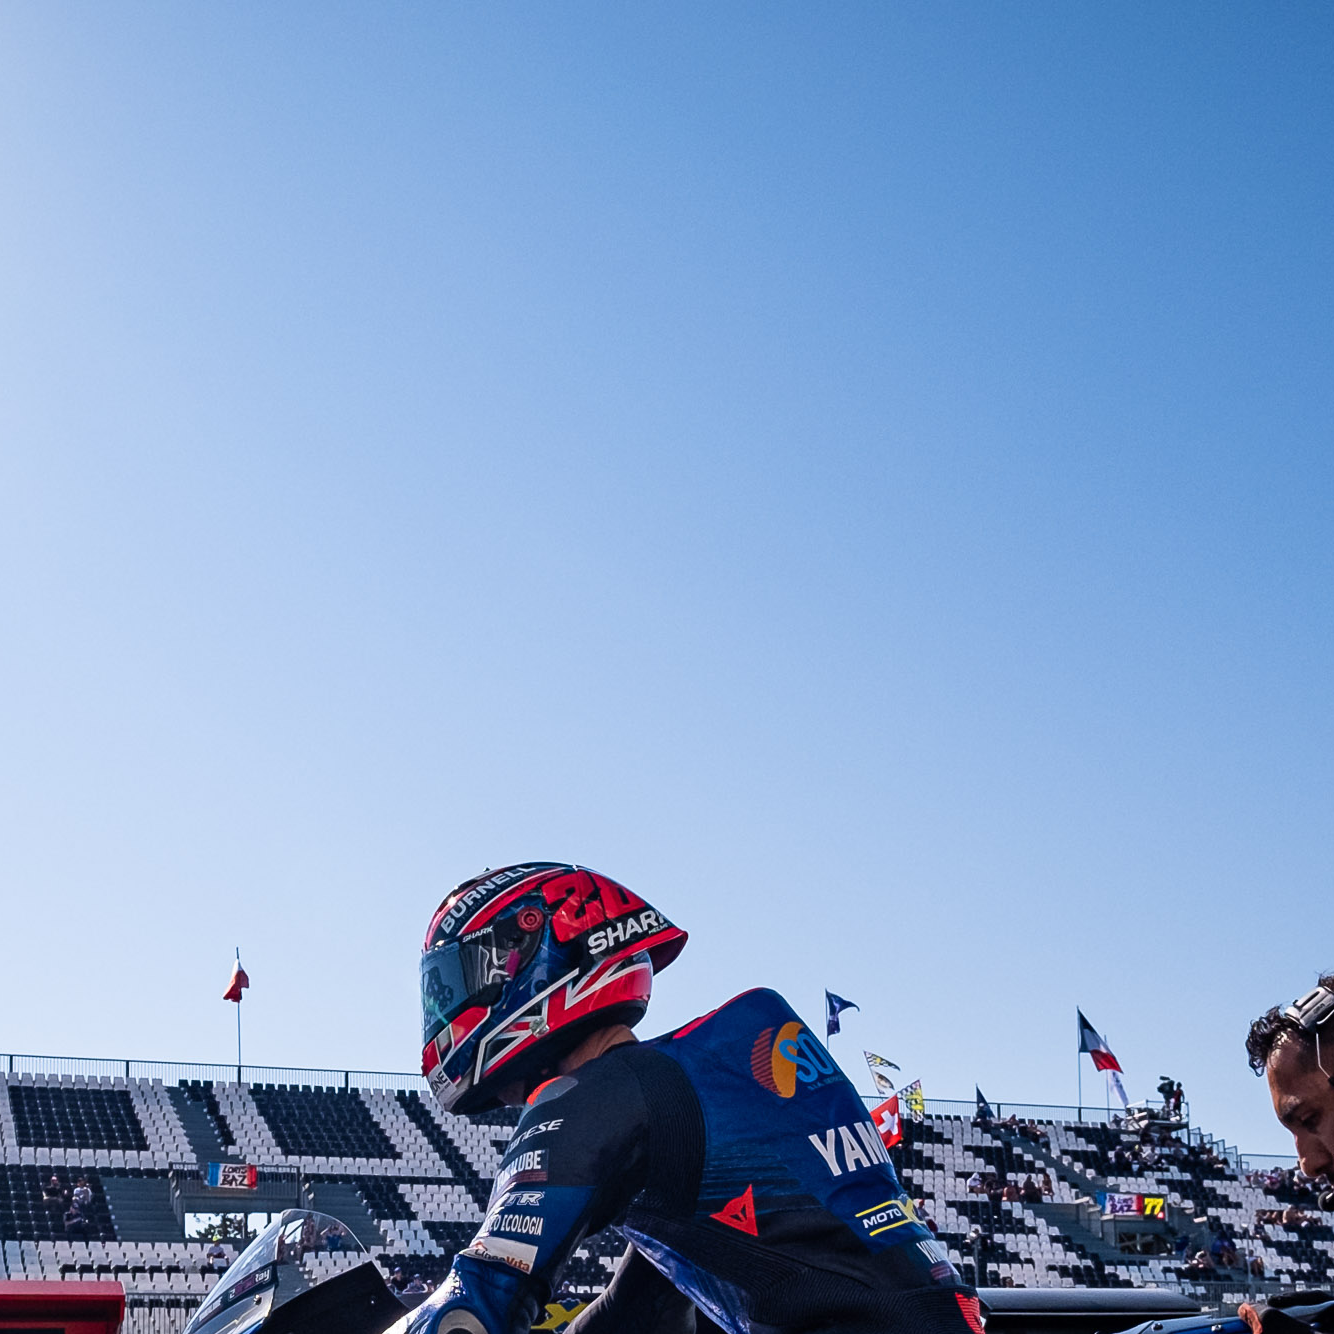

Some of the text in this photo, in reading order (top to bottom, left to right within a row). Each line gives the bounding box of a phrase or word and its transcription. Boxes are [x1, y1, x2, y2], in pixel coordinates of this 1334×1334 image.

[440, 867, 537, 934] BURNELL
[462, 925, 494, 943] SHARK
[220, 1175, 251, 1187] BAZ
[1144, 1198, 1164, 1215] 77
[500, 1215, 544, 1237] ECOLOGIA
